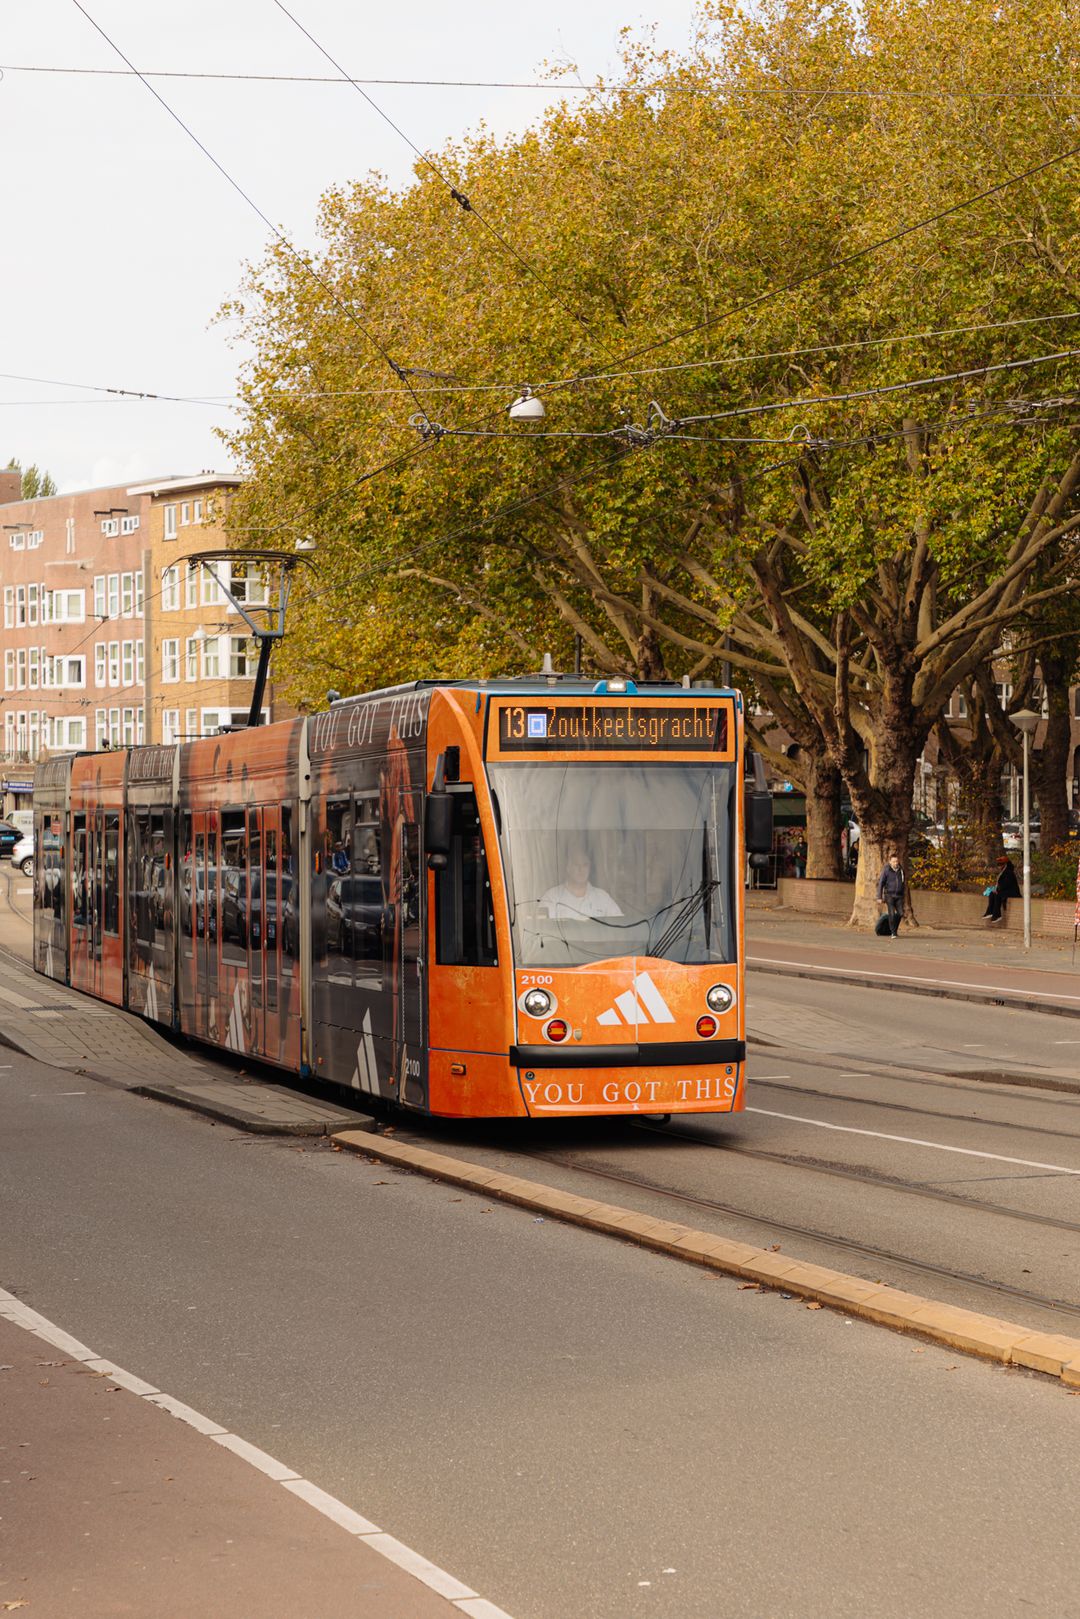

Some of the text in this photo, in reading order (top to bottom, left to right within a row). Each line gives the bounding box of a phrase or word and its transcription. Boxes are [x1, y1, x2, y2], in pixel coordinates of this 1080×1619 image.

[314, 692, 428, 752] YOU GOT THIS
[504, 706, 714, 745] 13 Zoutkeetsgracht
[520, 975, 553, 985] 2100
[405, 1058, 421, 1078] 2100
[524, 1077, 736, 1103] YOU GOT THIS
